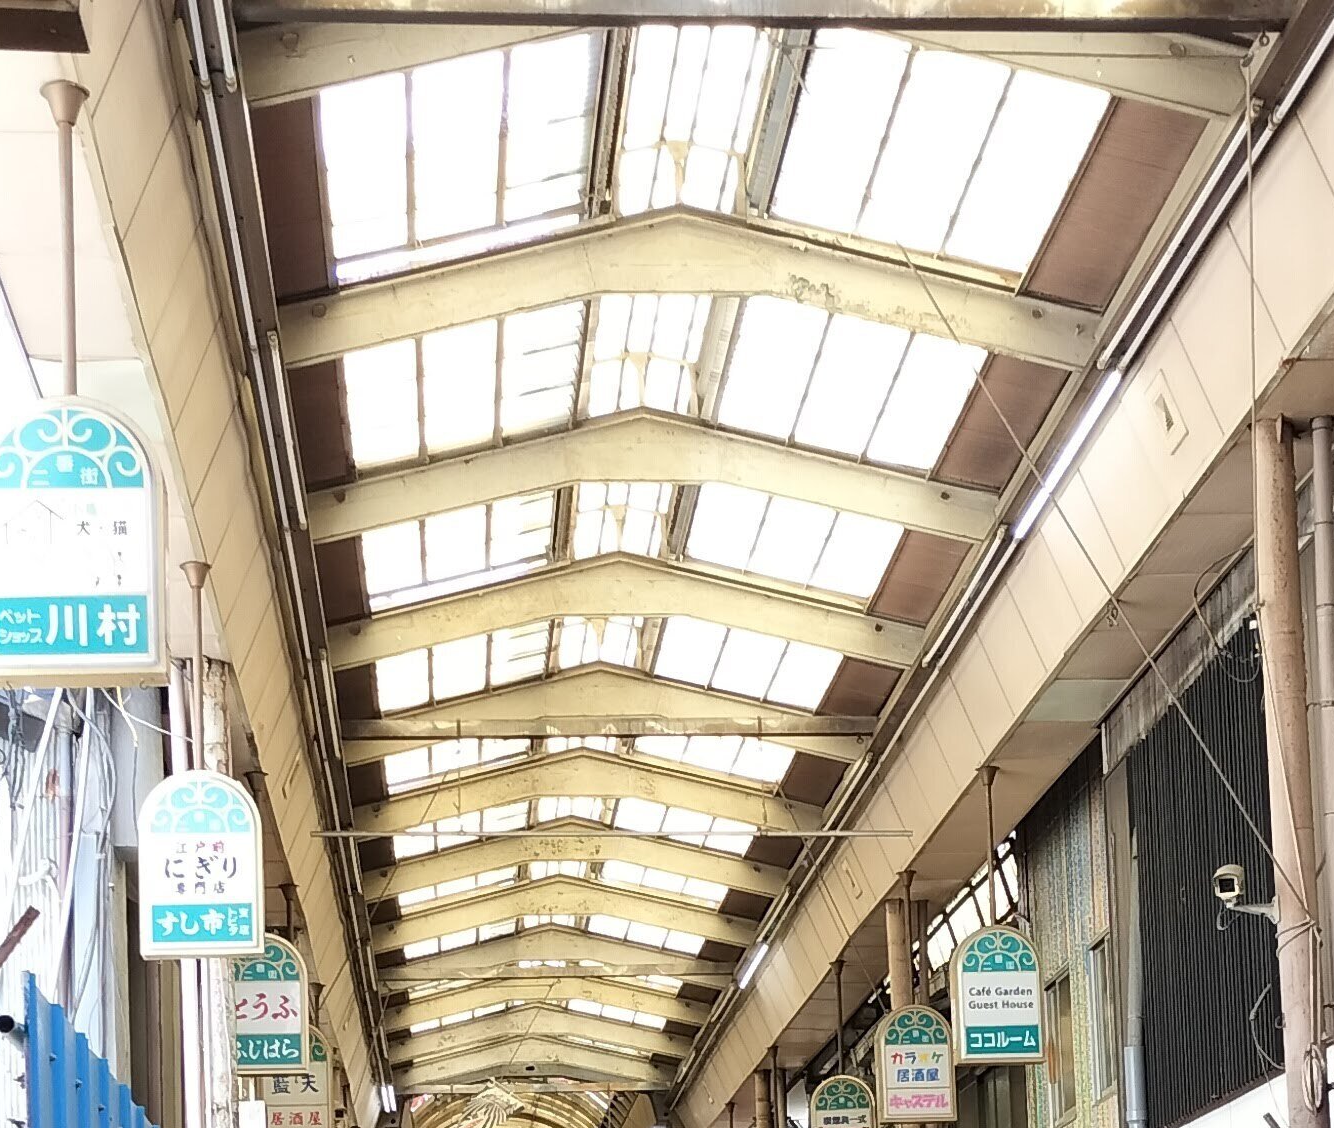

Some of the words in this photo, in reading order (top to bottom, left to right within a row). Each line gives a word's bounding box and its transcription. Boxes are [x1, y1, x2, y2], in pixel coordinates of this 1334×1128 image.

[45, 603, 141, 647] 川村
[164, 855, 237, 879] にぎり
[969, 986, 992, 996] Café
[995, 986, 1033, 996] Garden
[235, 992, 298, 1020] とうふ
[968, 1000, 999, 1010] Guest
[1002, 1000, 1034, 1009] House
[970, 1030, 1037, 1048] ココルーム
[270, 1111, 323, 1126] 居酒屋
